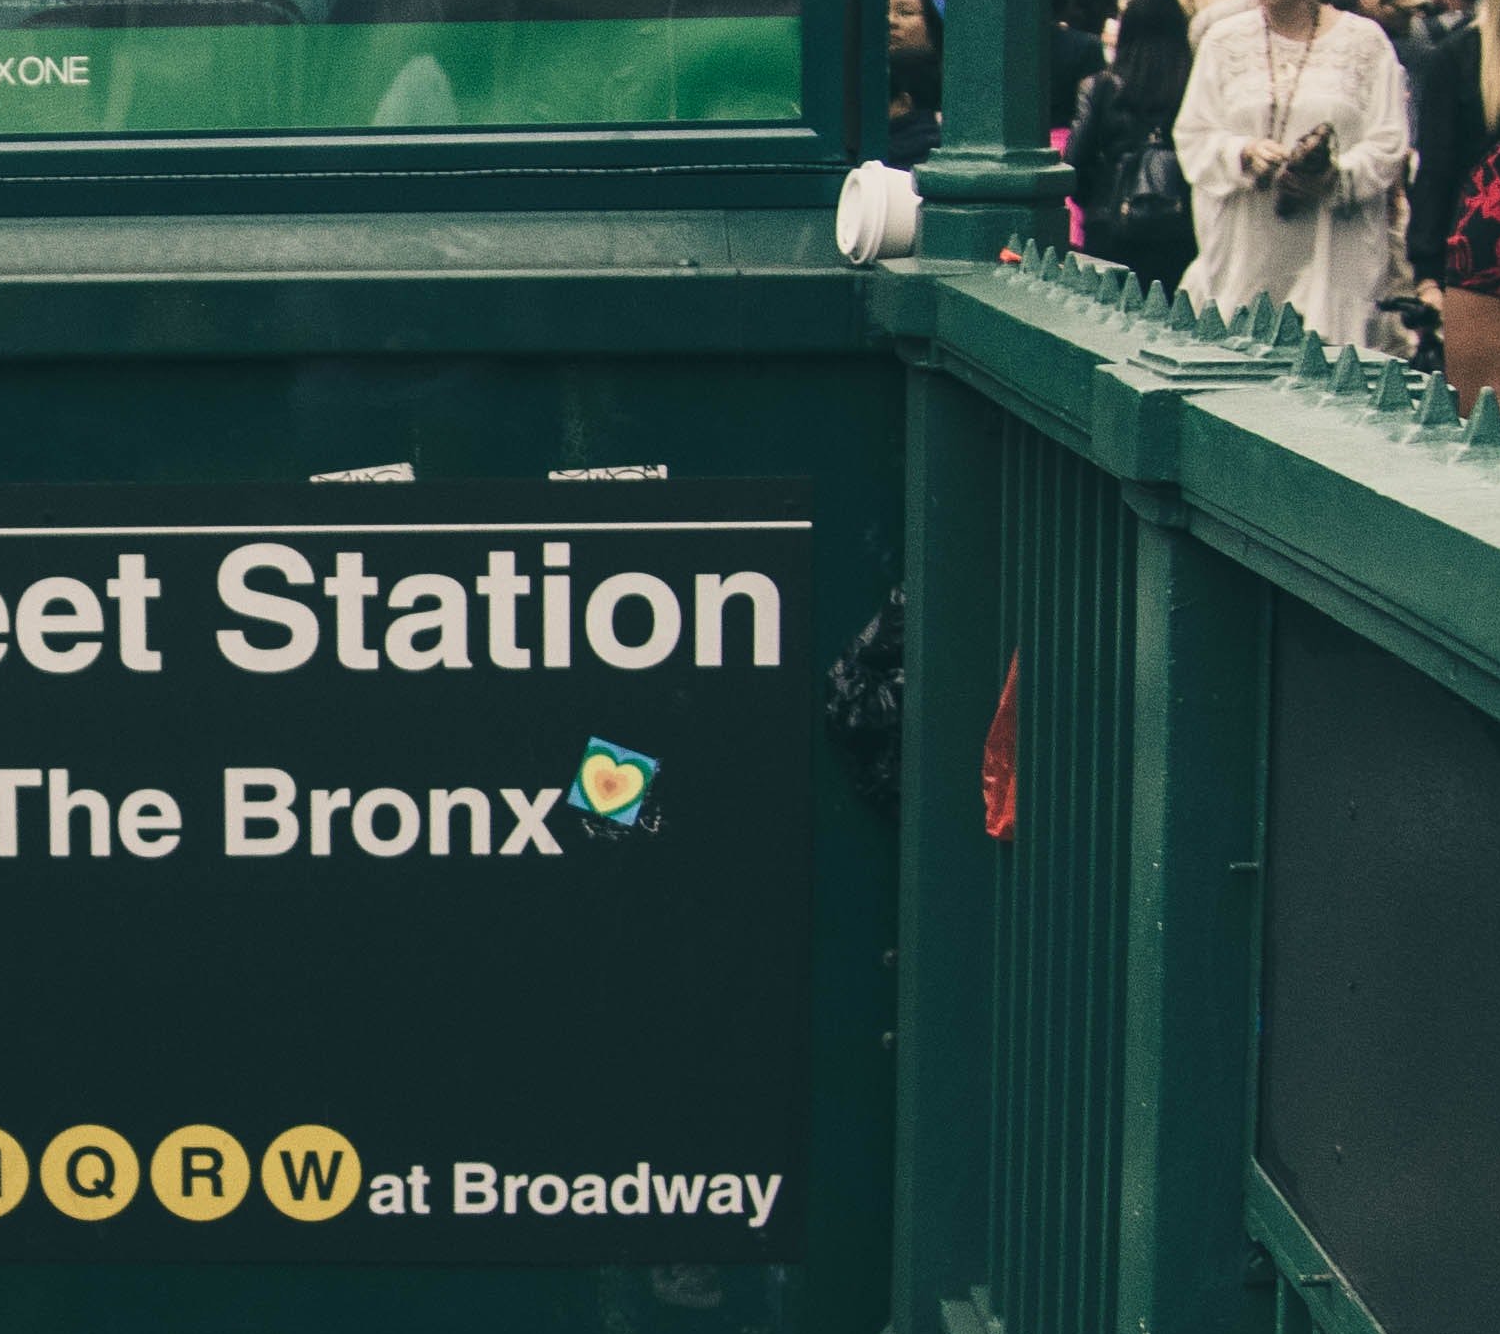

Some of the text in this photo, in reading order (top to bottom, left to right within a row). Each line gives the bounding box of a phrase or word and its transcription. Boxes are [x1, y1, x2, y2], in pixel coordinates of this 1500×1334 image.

[19, 55, 90, 86] ONE
[216, 541, 782, 673] Station
[224, 768, 563, 857] Bronx
[66, 1145, 115, 1201] Q
[180, 1147, 225, 1198] R
[278, 1148, 345, 1201] W
[368, 1165, 431, 1215] at
[453, 1161, 782, 1227] Broadway
